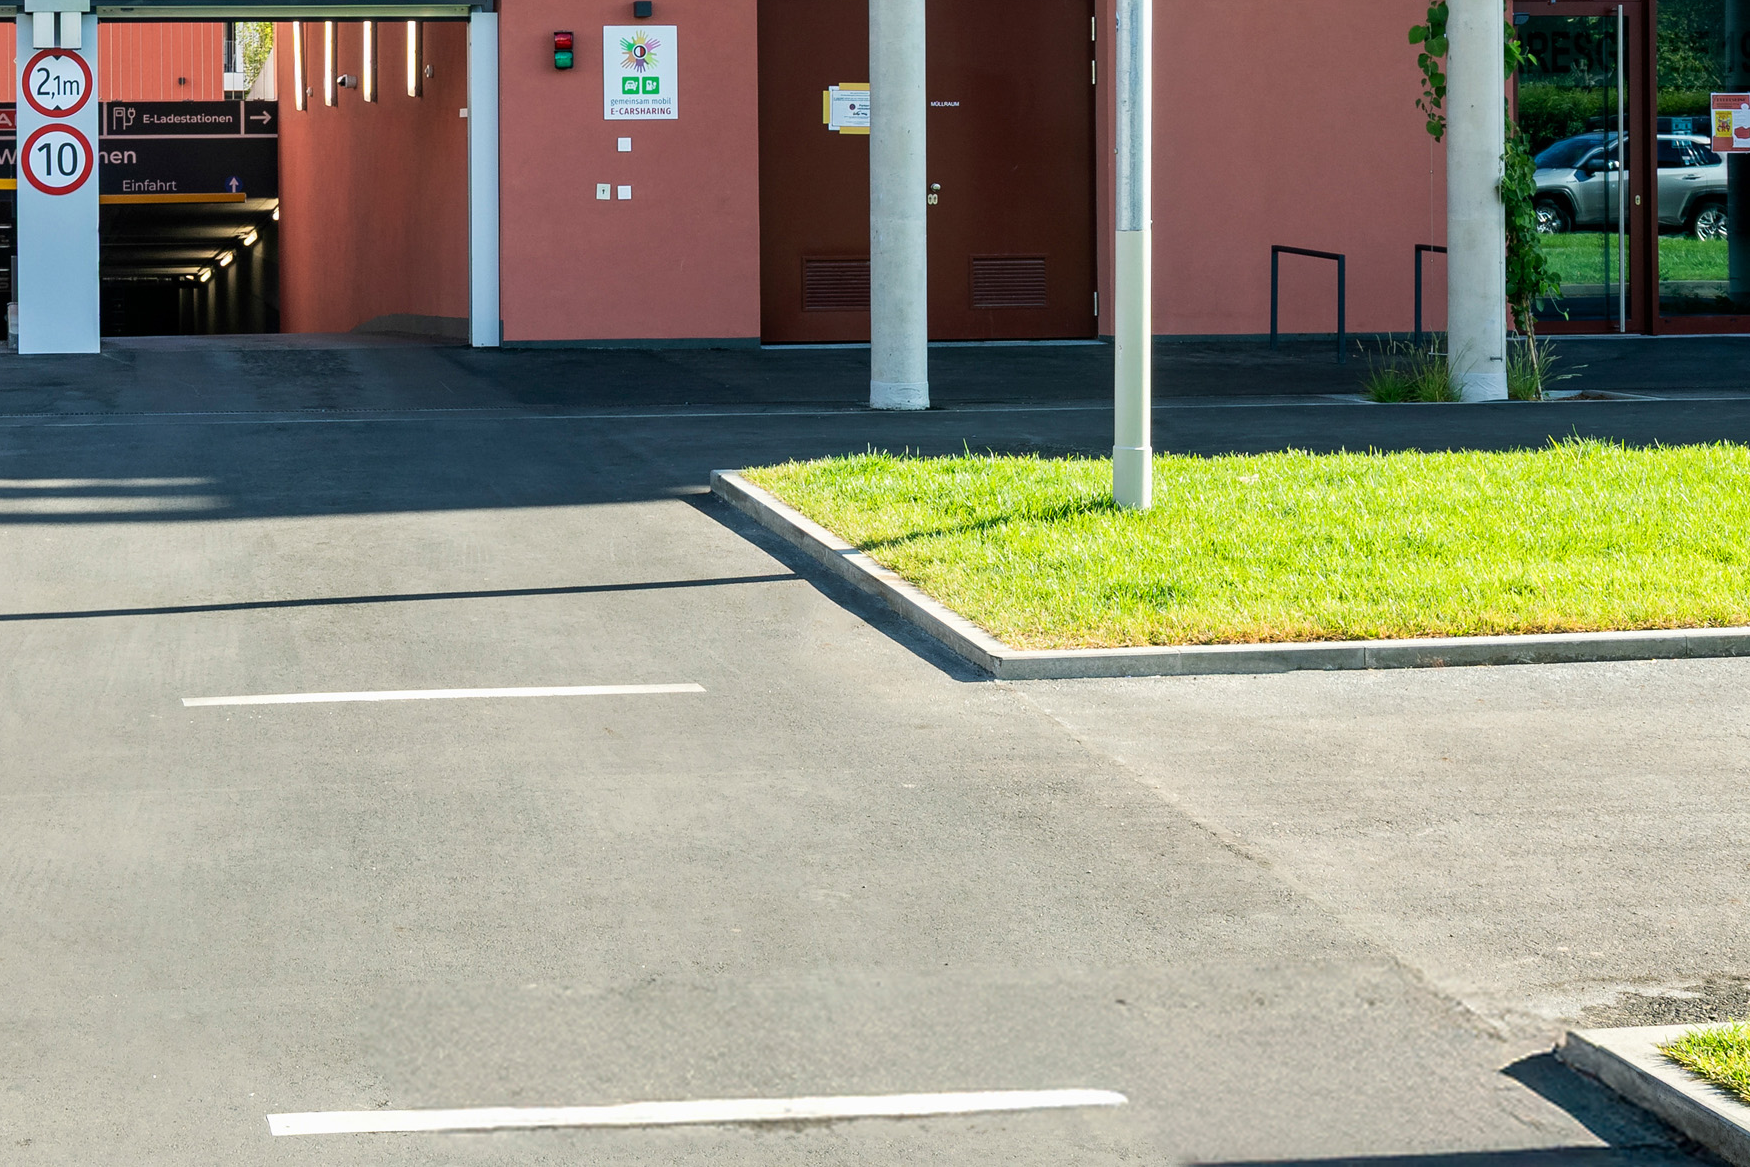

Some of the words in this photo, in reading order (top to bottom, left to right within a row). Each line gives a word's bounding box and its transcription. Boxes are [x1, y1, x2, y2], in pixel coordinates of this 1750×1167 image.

[36, 66, 81, 101] 2,1m
[610, 97, 650, 107] gemeinsam
[651, 97, 672, 105] mobil
[610, 107, 672, 116] E-CARSHARING
[143, 113, 233, 125] E-Ladestationen
[37, 142, 78, 177] 10
[122, 179, 178, 192] Einfahrt
